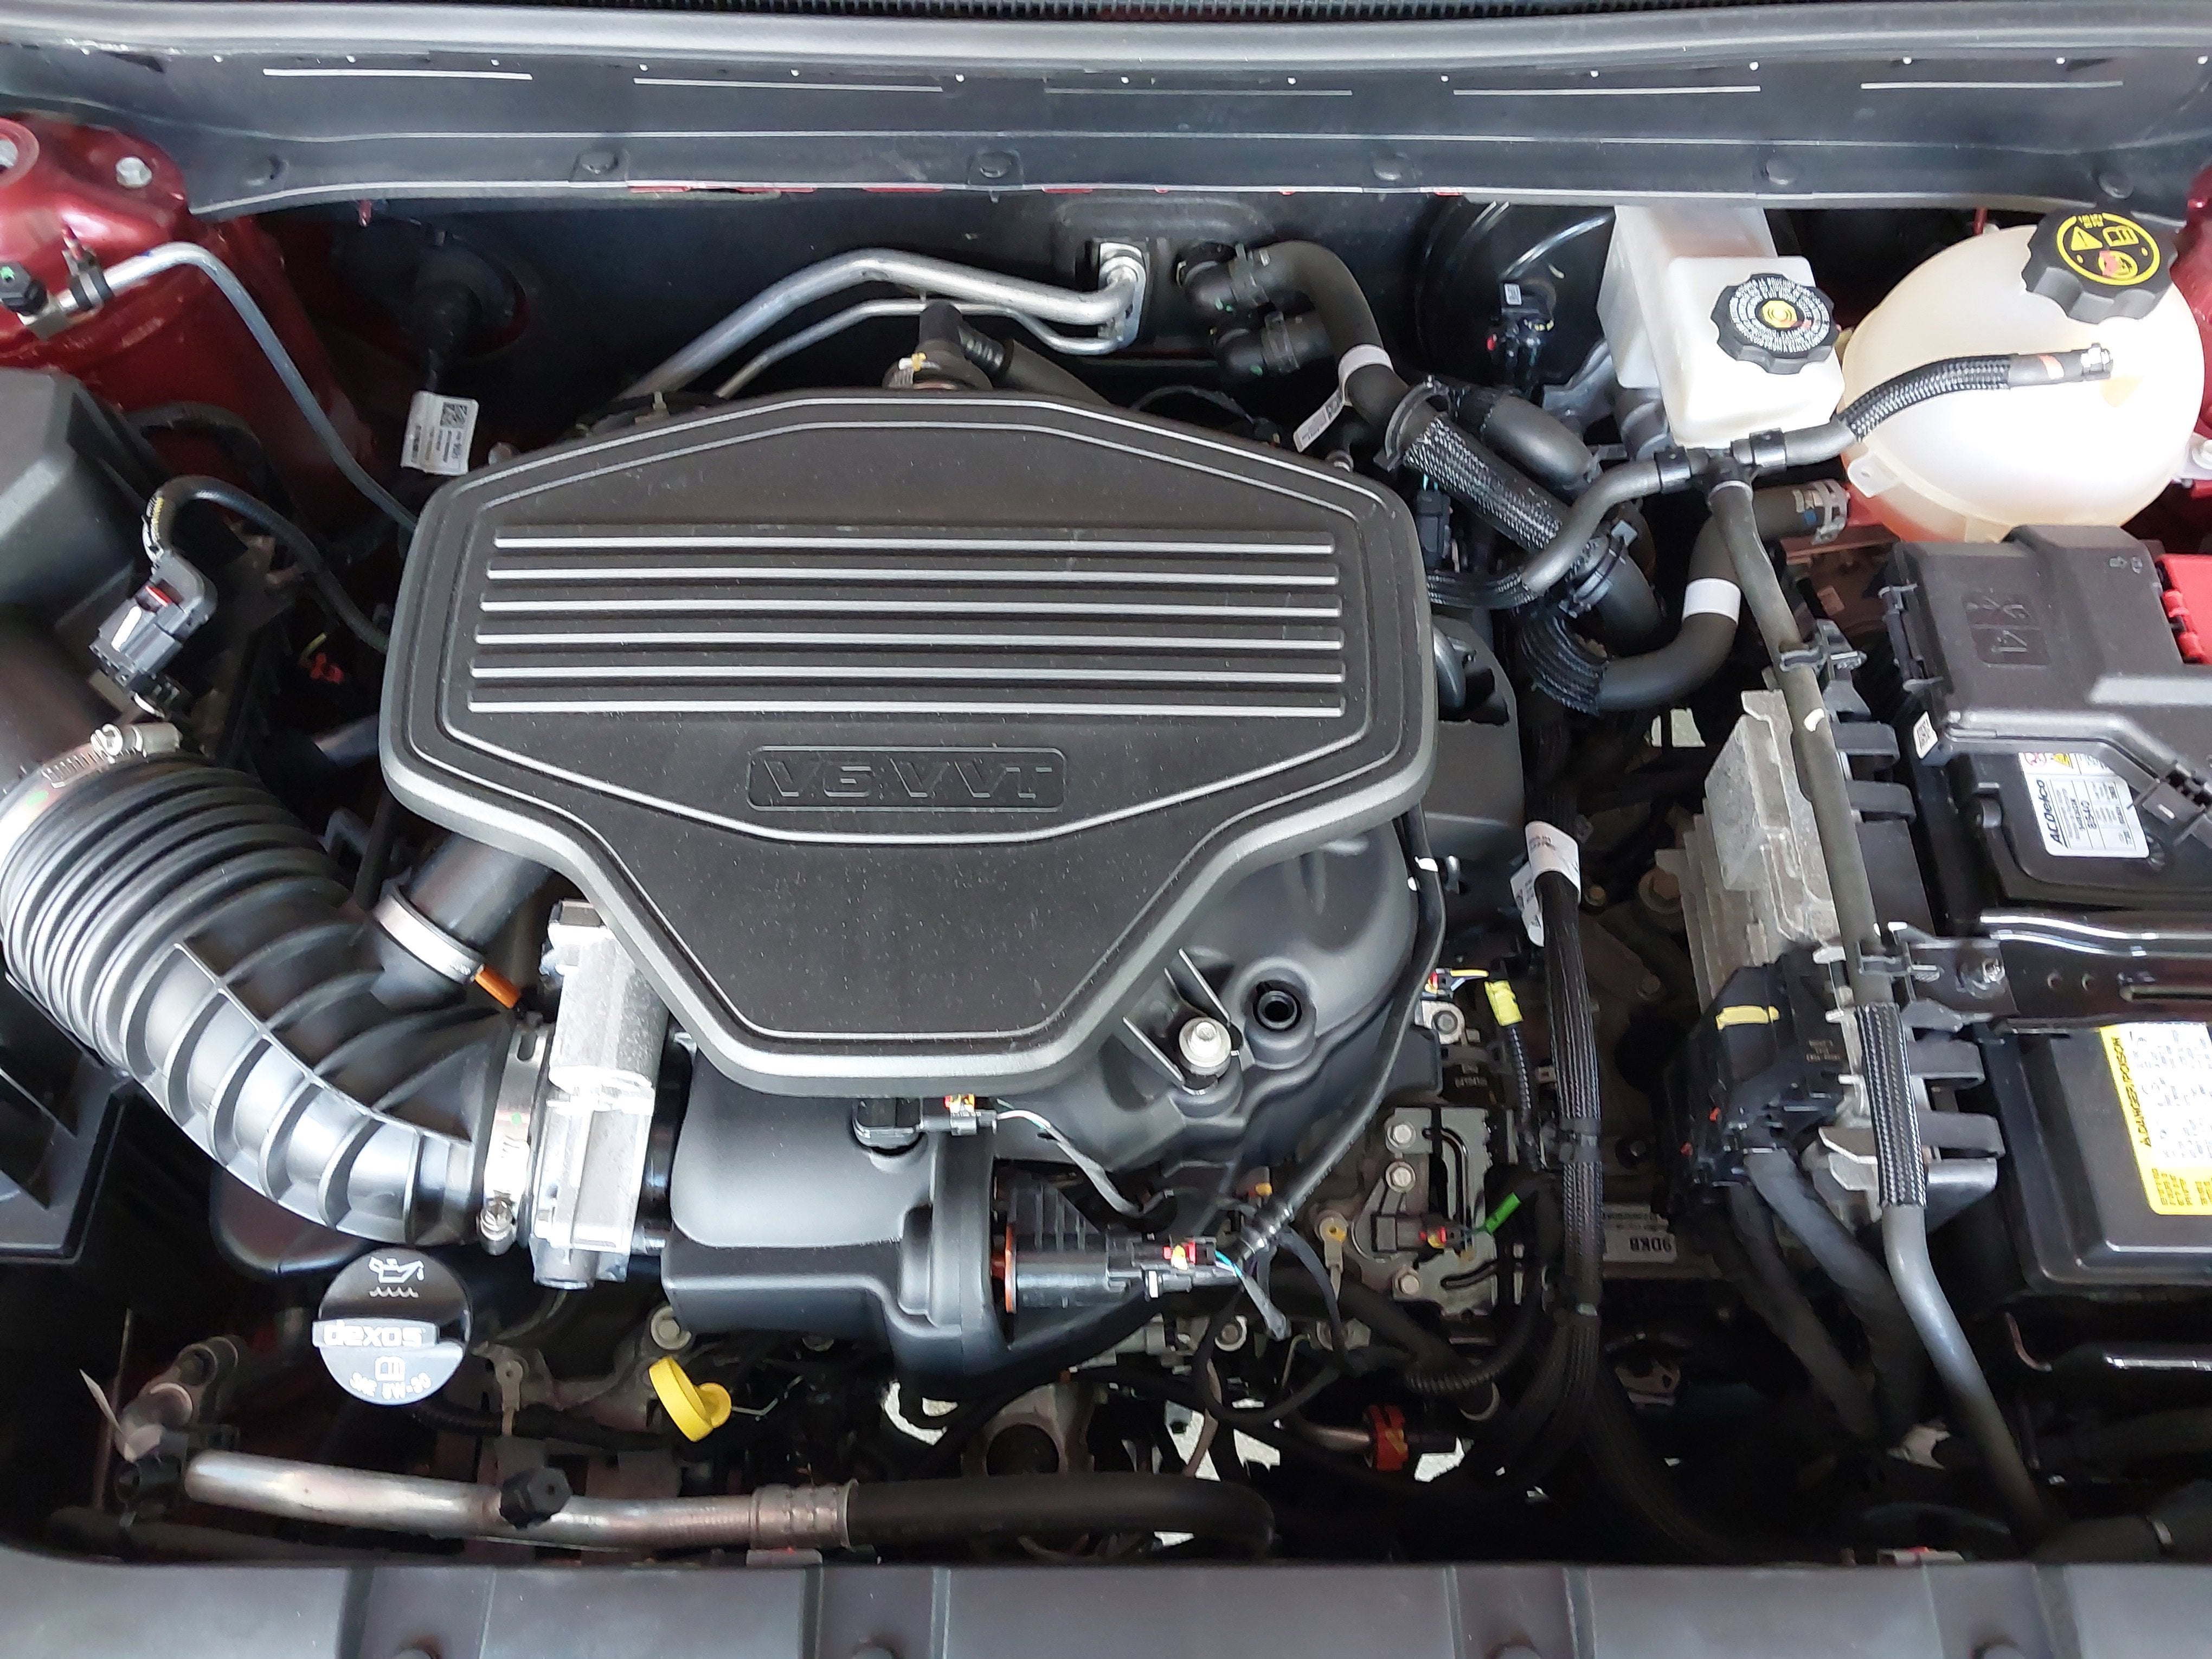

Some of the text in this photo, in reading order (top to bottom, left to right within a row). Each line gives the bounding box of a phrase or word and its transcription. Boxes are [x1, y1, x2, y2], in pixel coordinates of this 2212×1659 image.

[763, 758, 1053, 800] V6 VVT
[2036, 779, 2063, 846] ACDelco
